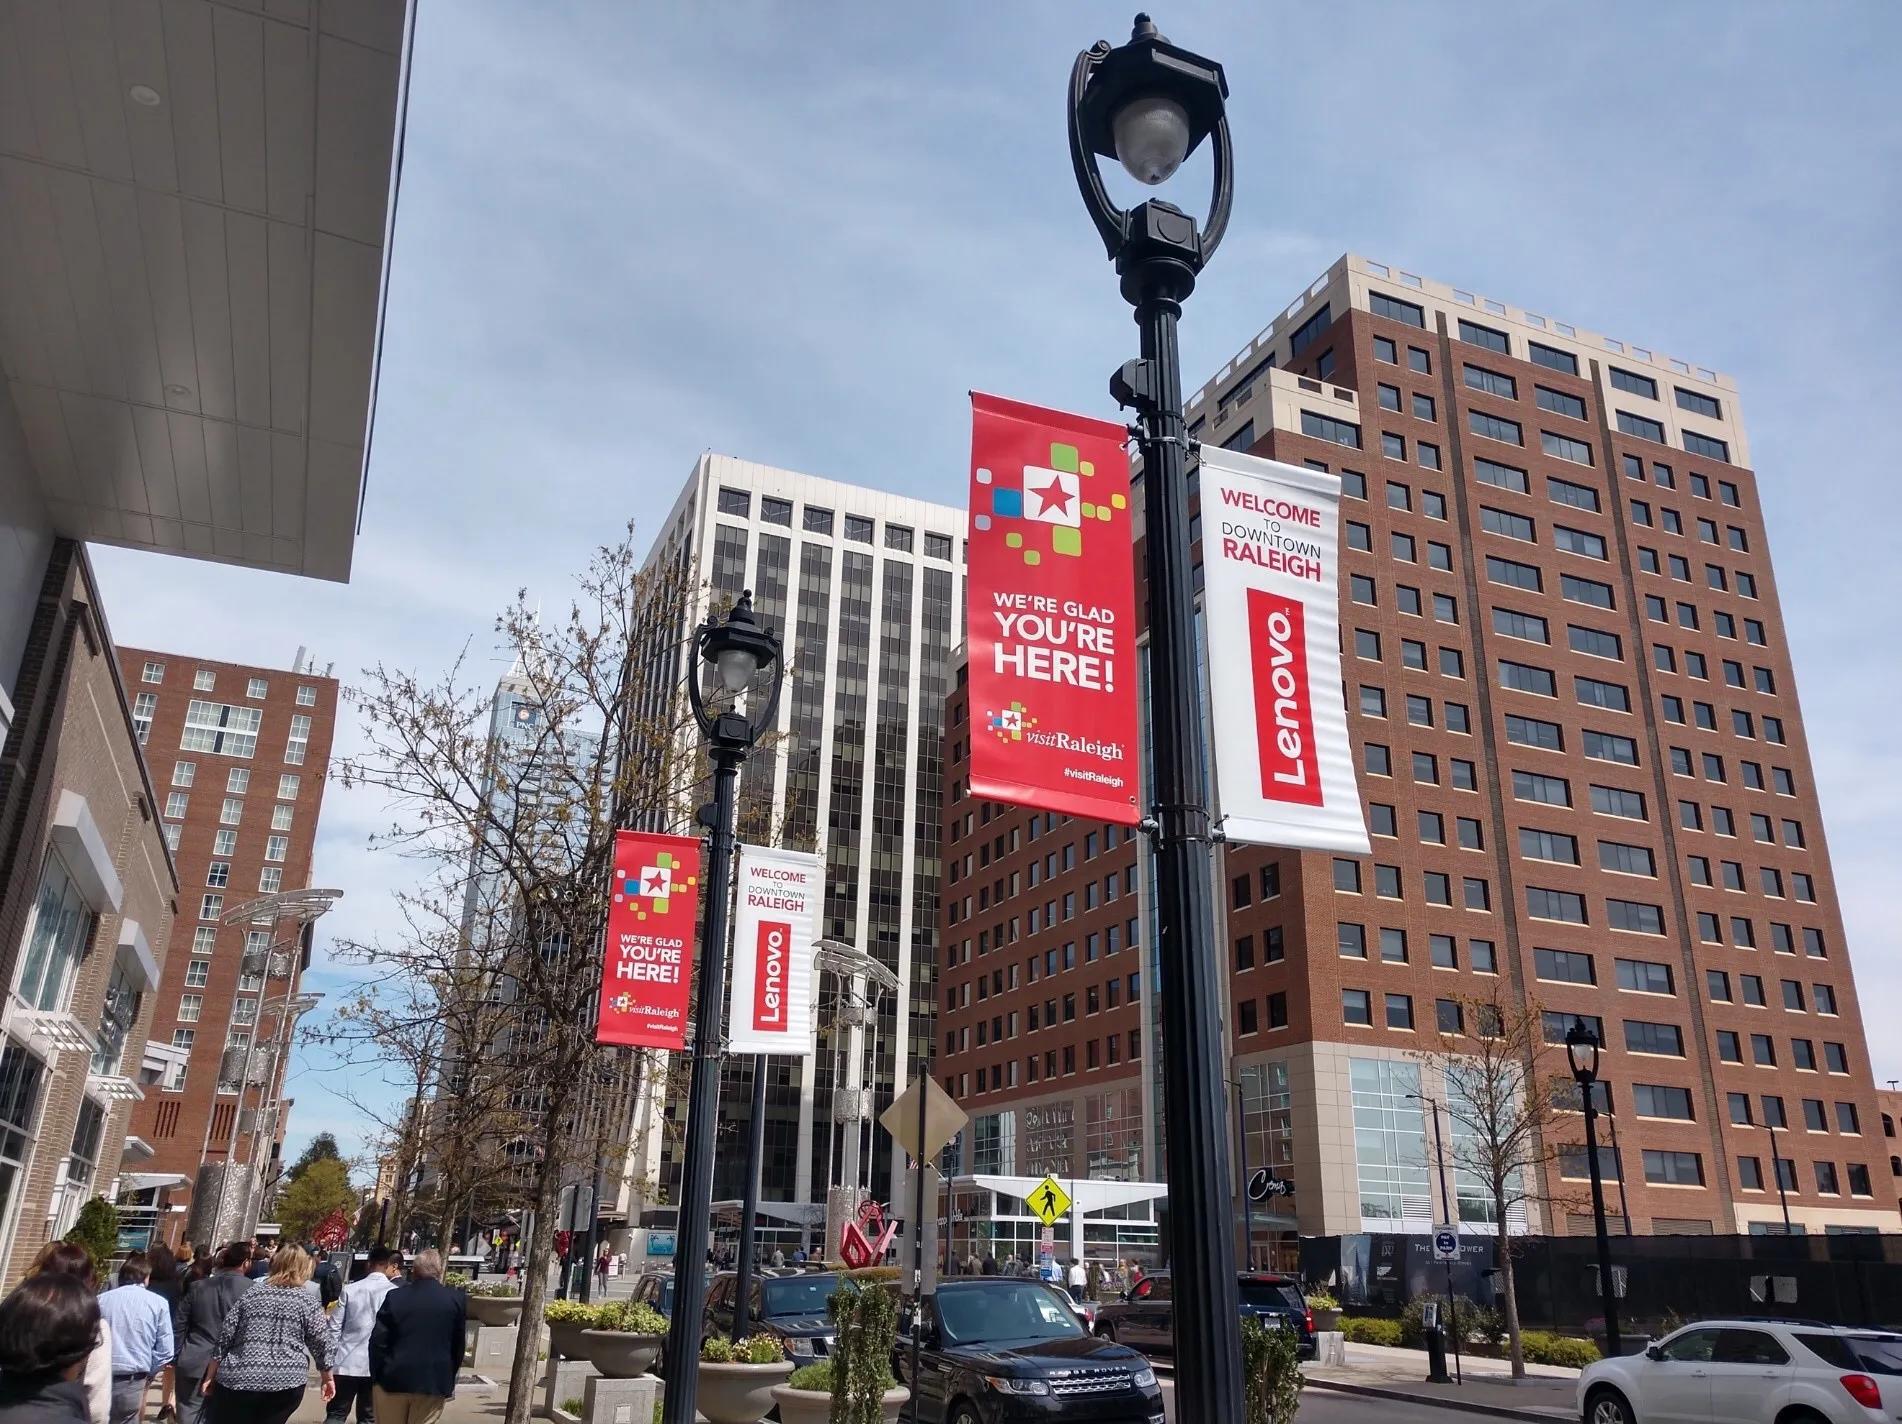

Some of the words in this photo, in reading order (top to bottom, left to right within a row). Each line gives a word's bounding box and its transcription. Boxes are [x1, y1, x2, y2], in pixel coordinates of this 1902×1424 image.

[1220, 487, 1321, 528] WELCOME
[1263, 518, 1281, 533] TO
[1222, 521, 1321, 559] DOWNTOWN
[1223, 537, 1321, 582] RALEIGH
[993, 592, 1058, 614] WE'RE
[1063, 601, 1115, 623] GLAD
[993, 611, 1115, 655] YOU'RE
[994, 642, 1114, 693] HERE!
[1026, 730, 1124, 761] visitRaleigh
[1063, 767, 1124, 788] #visitRaleigh
[750, 866, 807, 884] WELCOME
[773, 881, 783, 889] TO
[748, 885, 805, 900] DOWNTOWN
[747, 894, 805, 913] RALEIGH
[620, 934, 653, 945] WE'RE
[655, 937, 683, 948] GLAD
[619, 944, 682, 964] YOU'RE
[616, 960, 680, 984] HERE!
[760, 930, 784, 1023] Lenovo
[1415, 1243, 1430, 1252] THE
[1459, 1245, 1484, 1253] OWER
[1093, 1366, 1127, 1374] ROVER
